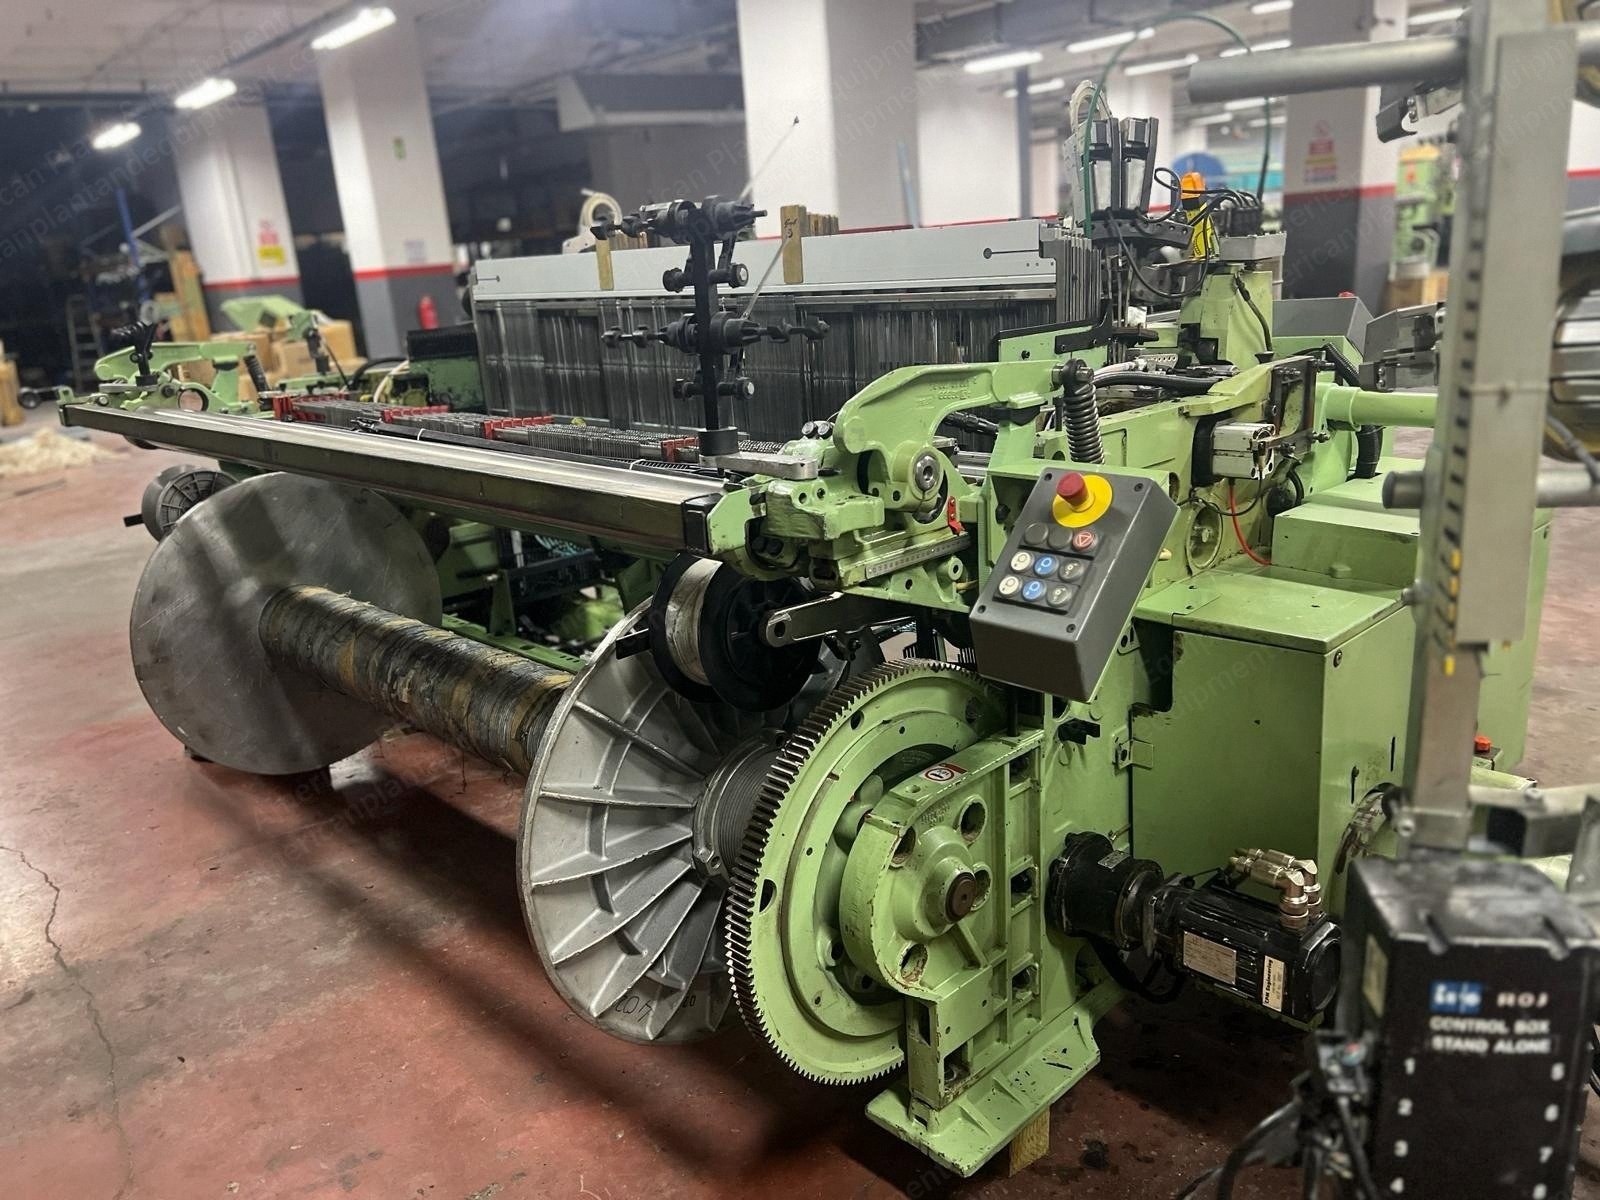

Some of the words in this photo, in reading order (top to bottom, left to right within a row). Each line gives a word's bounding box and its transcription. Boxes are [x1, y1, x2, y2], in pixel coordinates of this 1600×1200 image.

[1429, 1016, 1509, 1033] CONTROL
[1513, 1019, 1550, 1034] BOX
[1431, 1035, 1489, 1053] STAND
[1493, 1037, 1551, 1054] ALONE
[1404, 1058, 1416, 1075] 1
